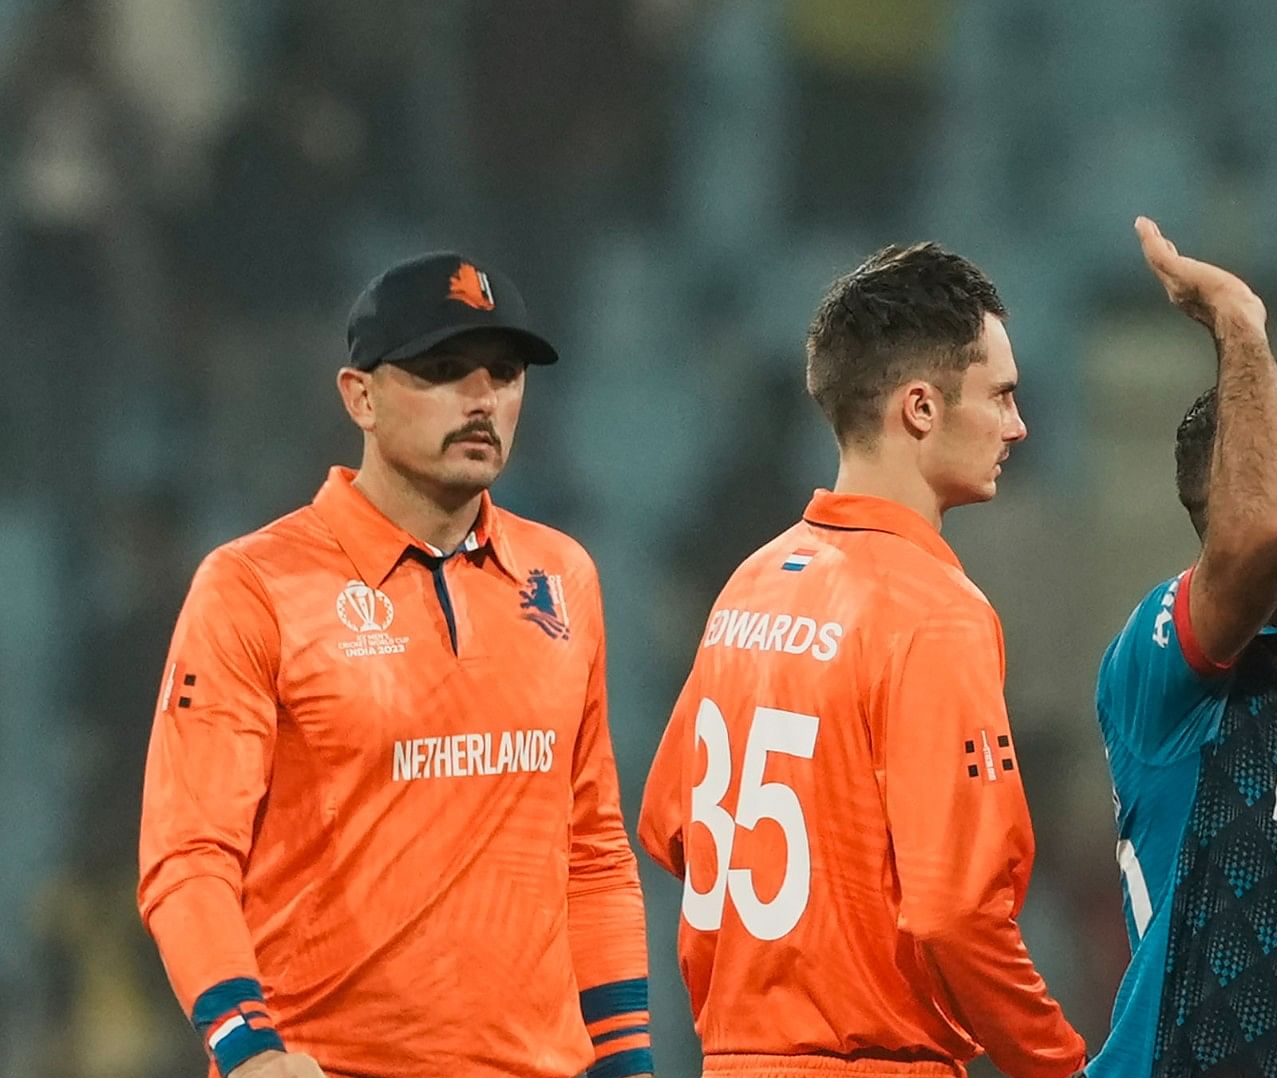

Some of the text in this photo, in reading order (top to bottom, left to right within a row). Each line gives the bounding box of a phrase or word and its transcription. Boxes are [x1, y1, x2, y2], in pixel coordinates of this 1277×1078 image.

[703, 609, 843, 662] EDWARDS
[393, 729, 556, 781] NETHERLANDS
[682, 697, 820, 941] 35
